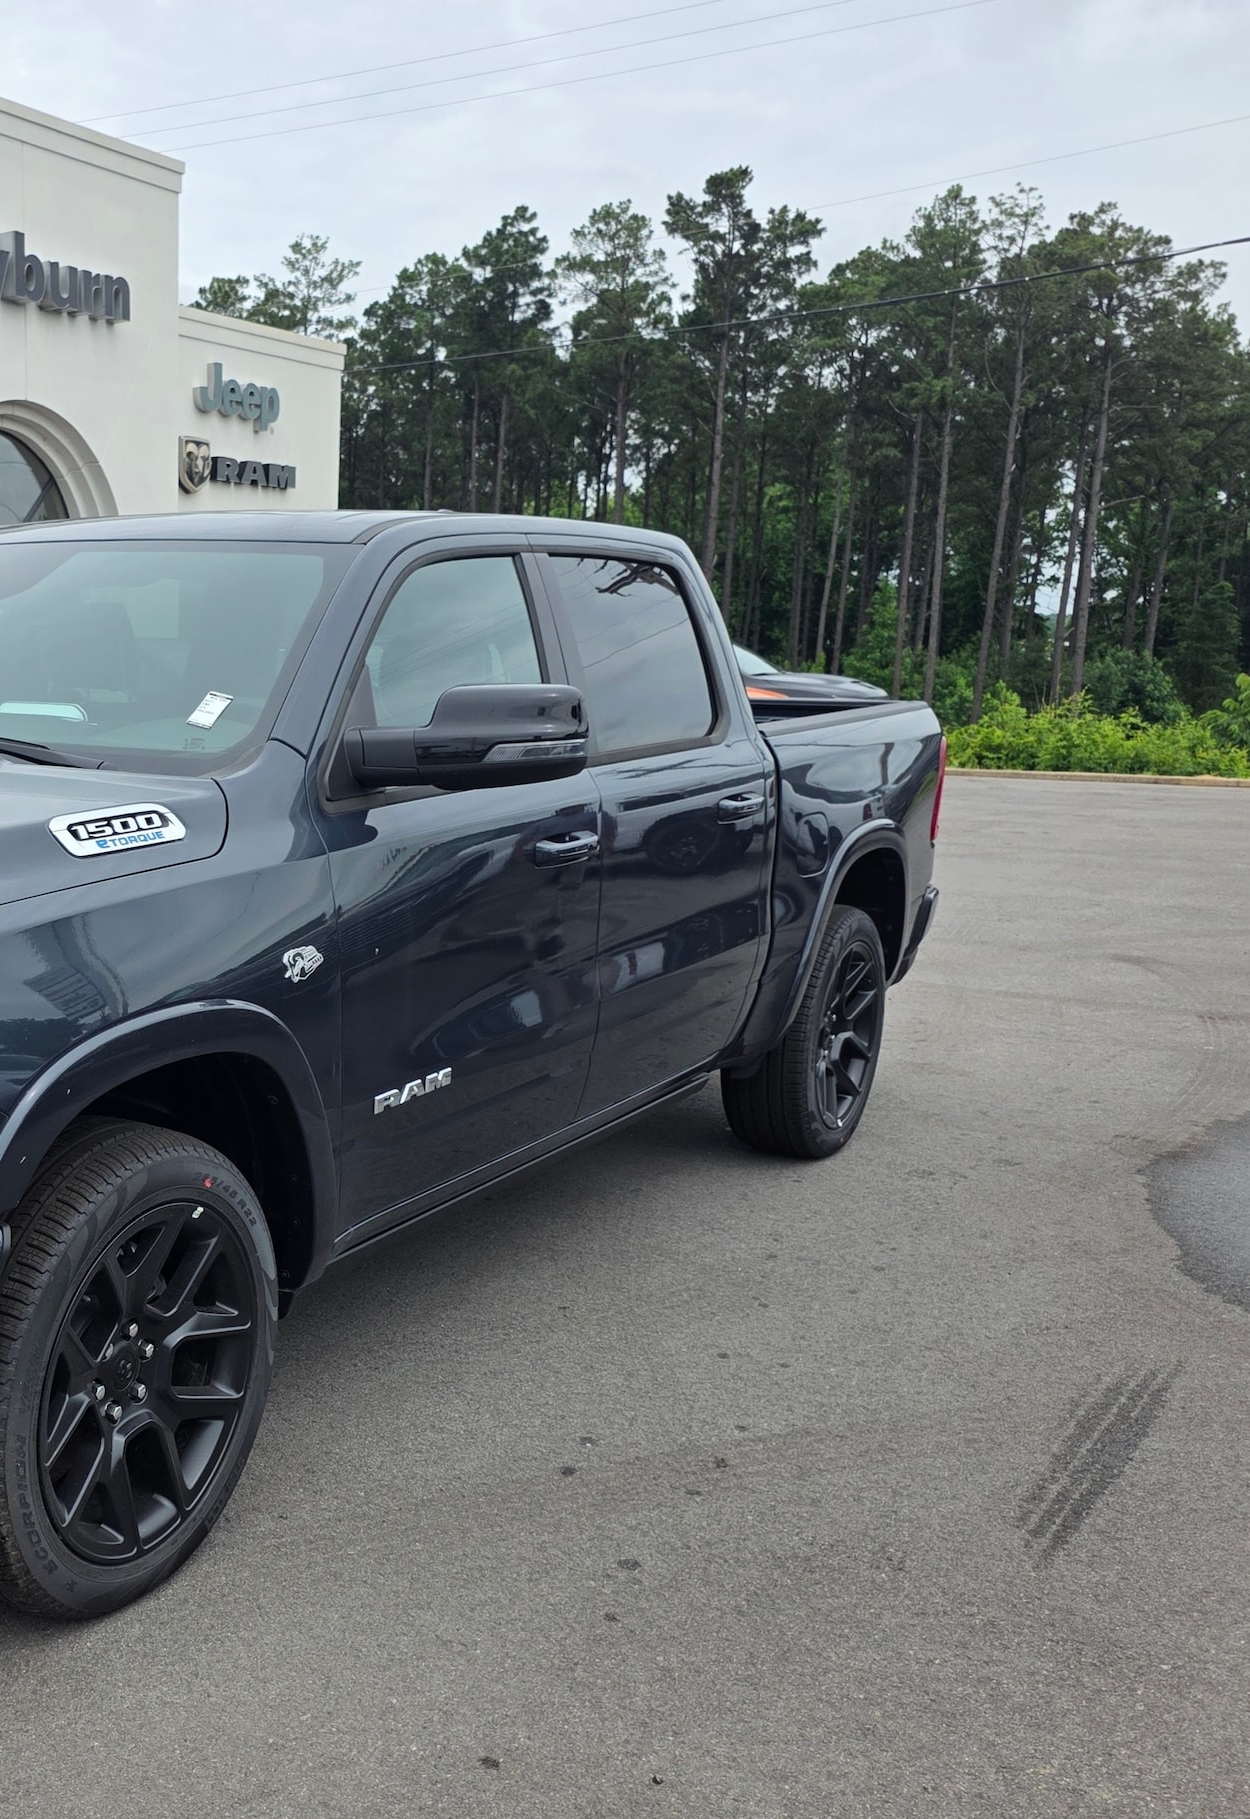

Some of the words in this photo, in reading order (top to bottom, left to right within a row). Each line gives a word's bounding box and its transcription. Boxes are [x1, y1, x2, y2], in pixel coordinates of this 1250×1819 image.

[192, 361, 280, 432] Jeep
[209, 456, 296, 489] RAM
[70, 813, 163, 840] 1500
[373, 1066, 453, 1115] RAM
